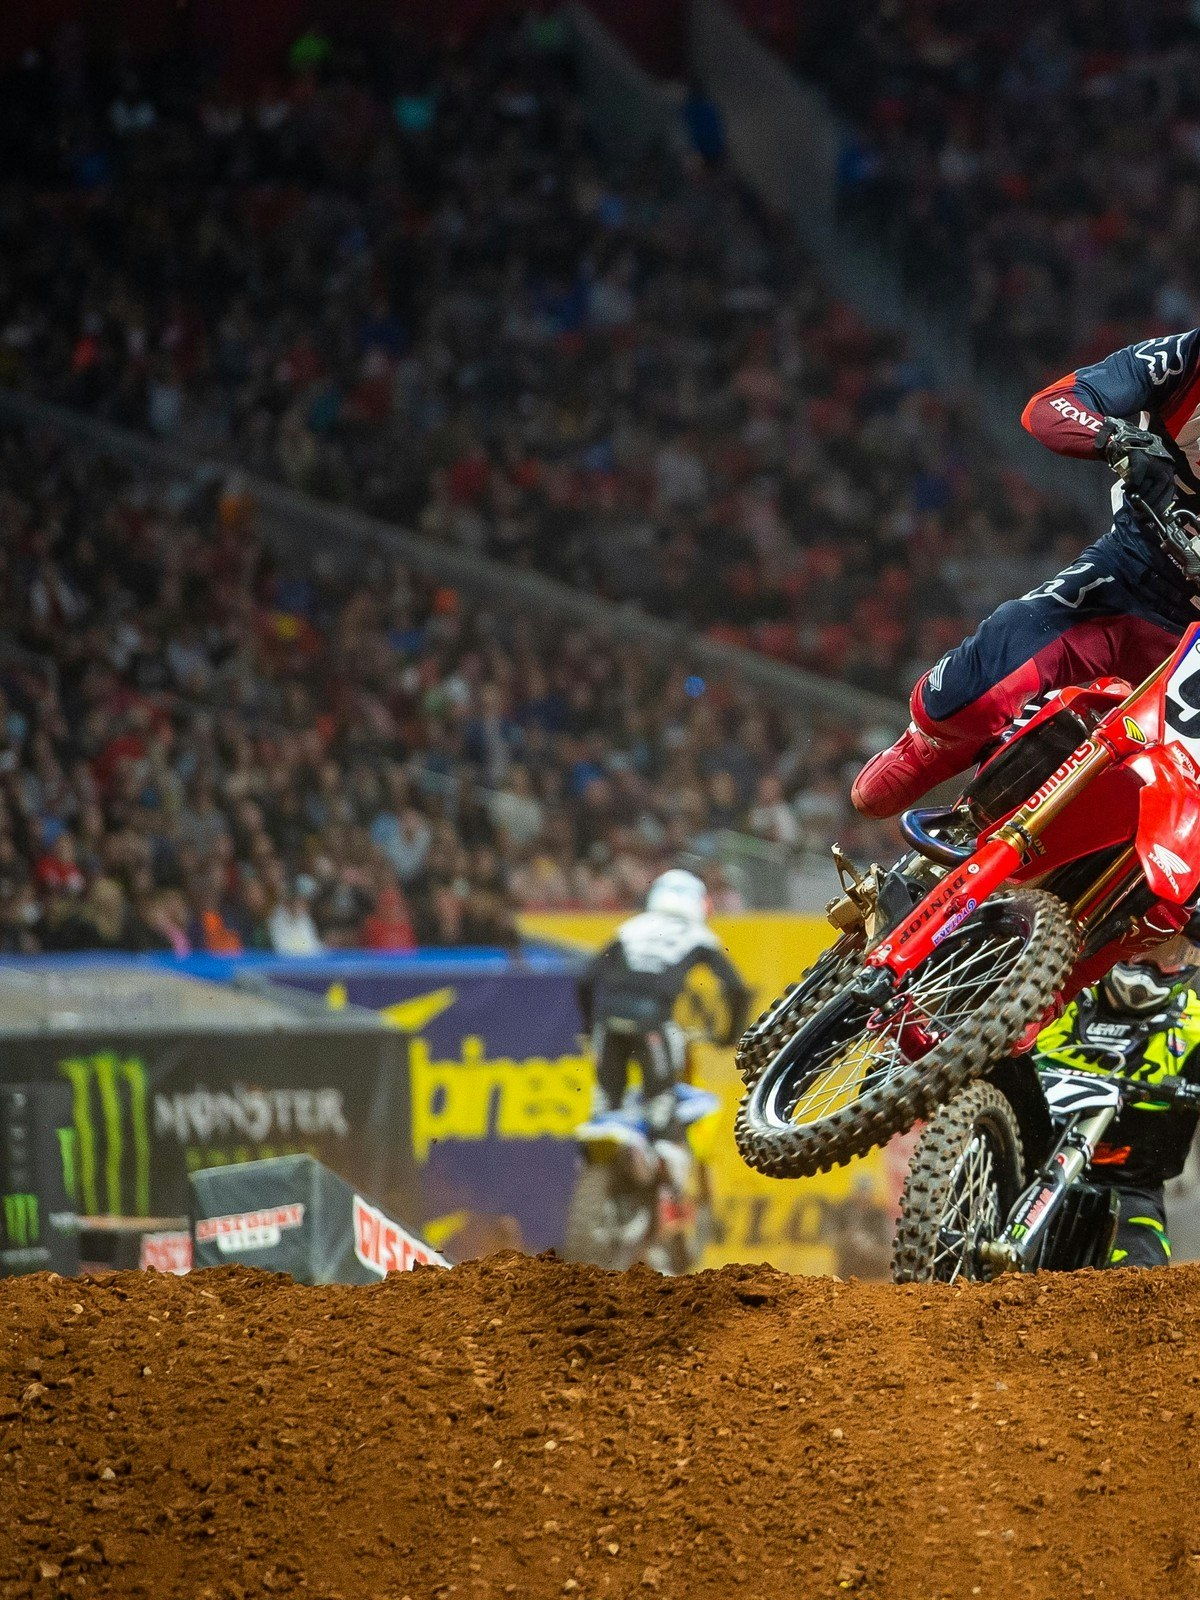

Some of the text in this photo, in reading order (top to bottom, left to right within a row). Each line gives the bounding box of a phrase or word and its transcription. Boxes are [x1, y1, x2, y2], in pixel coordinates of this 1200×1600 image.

[1049, 397, 1104, 432] HOND
[1147, 851, 1180, 896] HONDA
[899, 874, 967, 945] DUNLOP
[153, 1083, 349, 1144] MONSTER
